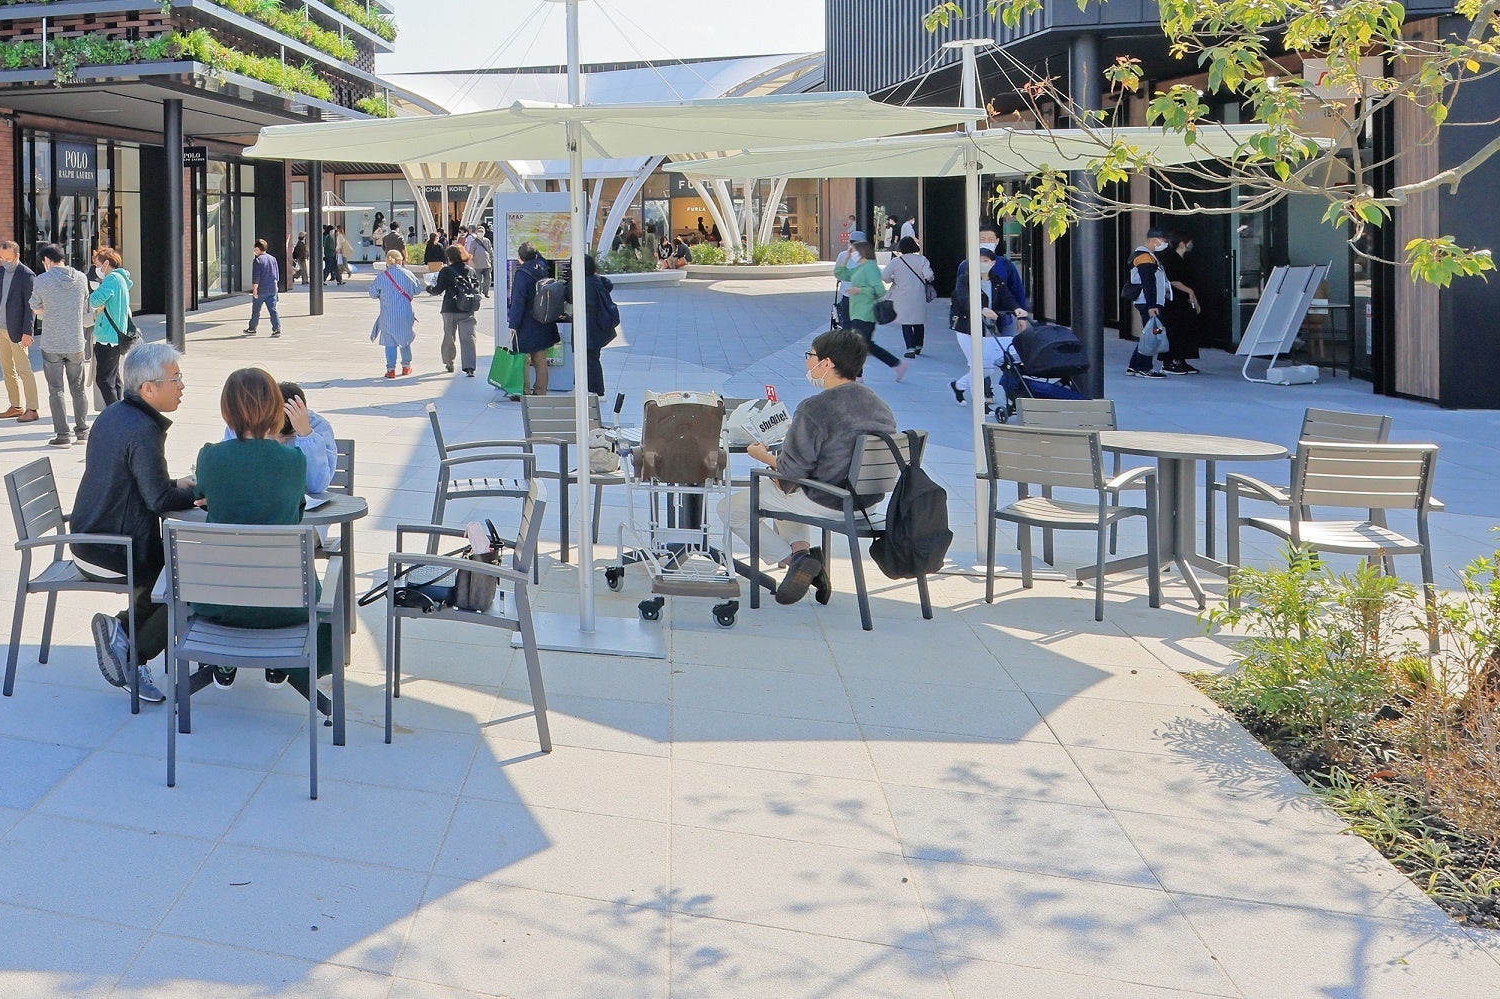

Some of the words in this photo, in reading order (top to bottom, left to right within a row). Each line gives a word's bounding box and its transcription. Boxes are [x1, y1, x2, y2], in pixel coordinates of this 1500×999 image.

[65, 150, 88, 169] POLO
[58, 170, 75, 179] RALPH
[76, 170, 94, 180] LAUREN
